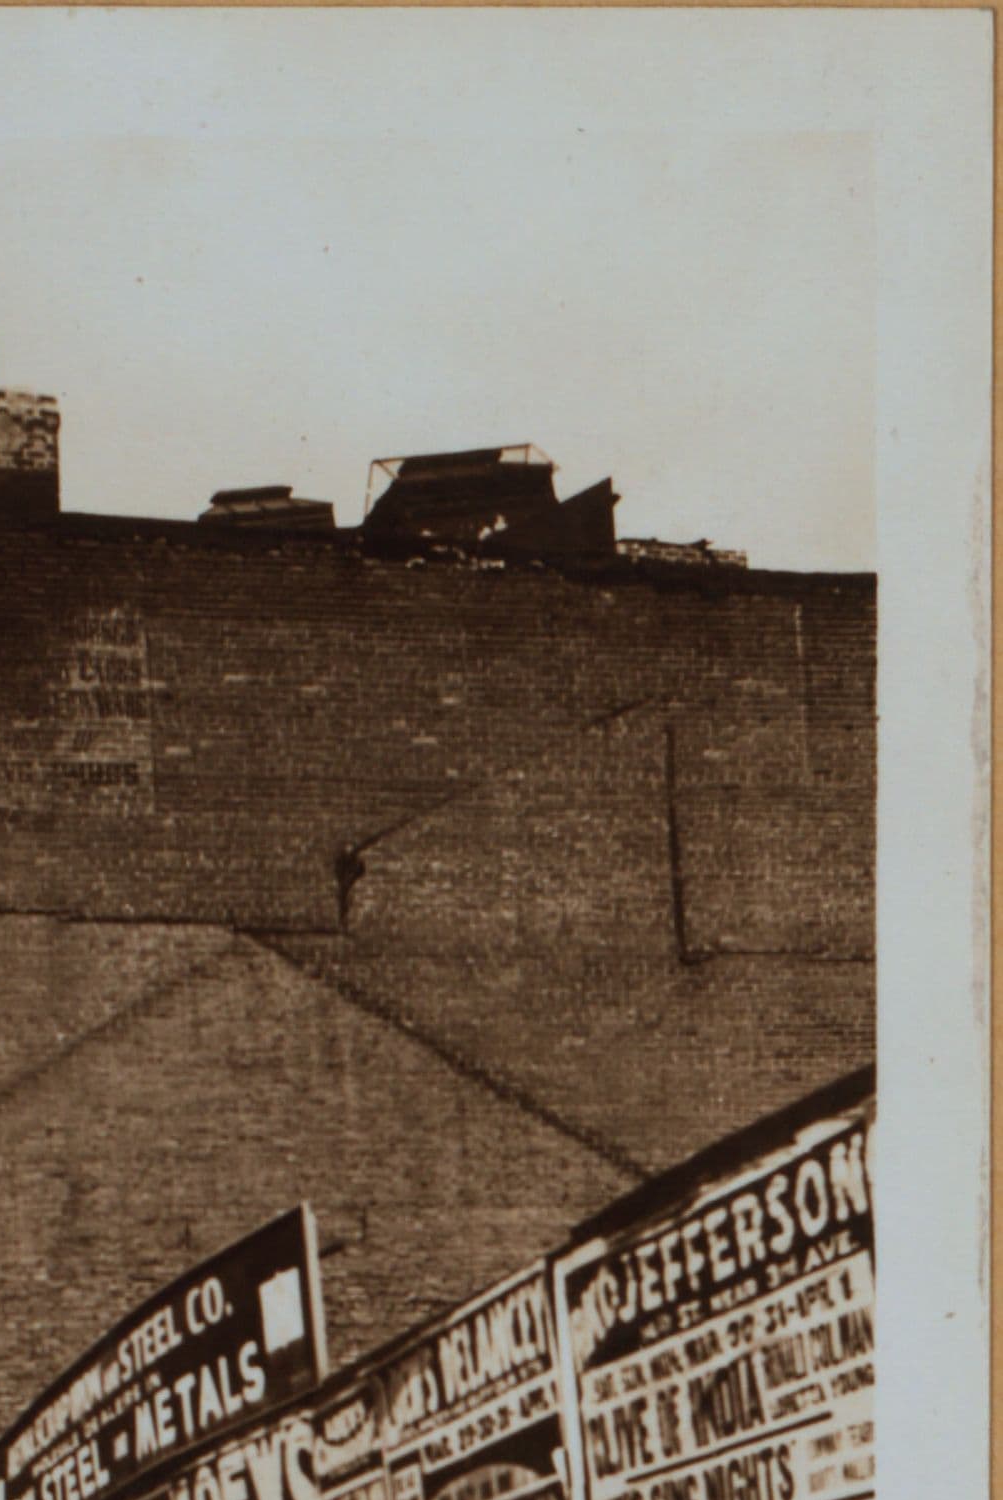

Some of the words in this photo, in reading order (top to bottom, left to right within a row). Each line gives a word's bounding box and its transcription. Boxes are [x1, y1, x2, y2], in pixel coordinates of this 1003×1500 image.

[619, 1133, 868, 1323] JEFFERSON
[118, 1305, 183, 1382] STEEL
[185, 1276, 234, 1335] CO.
[134, 1340, 266, 1462] METALS
